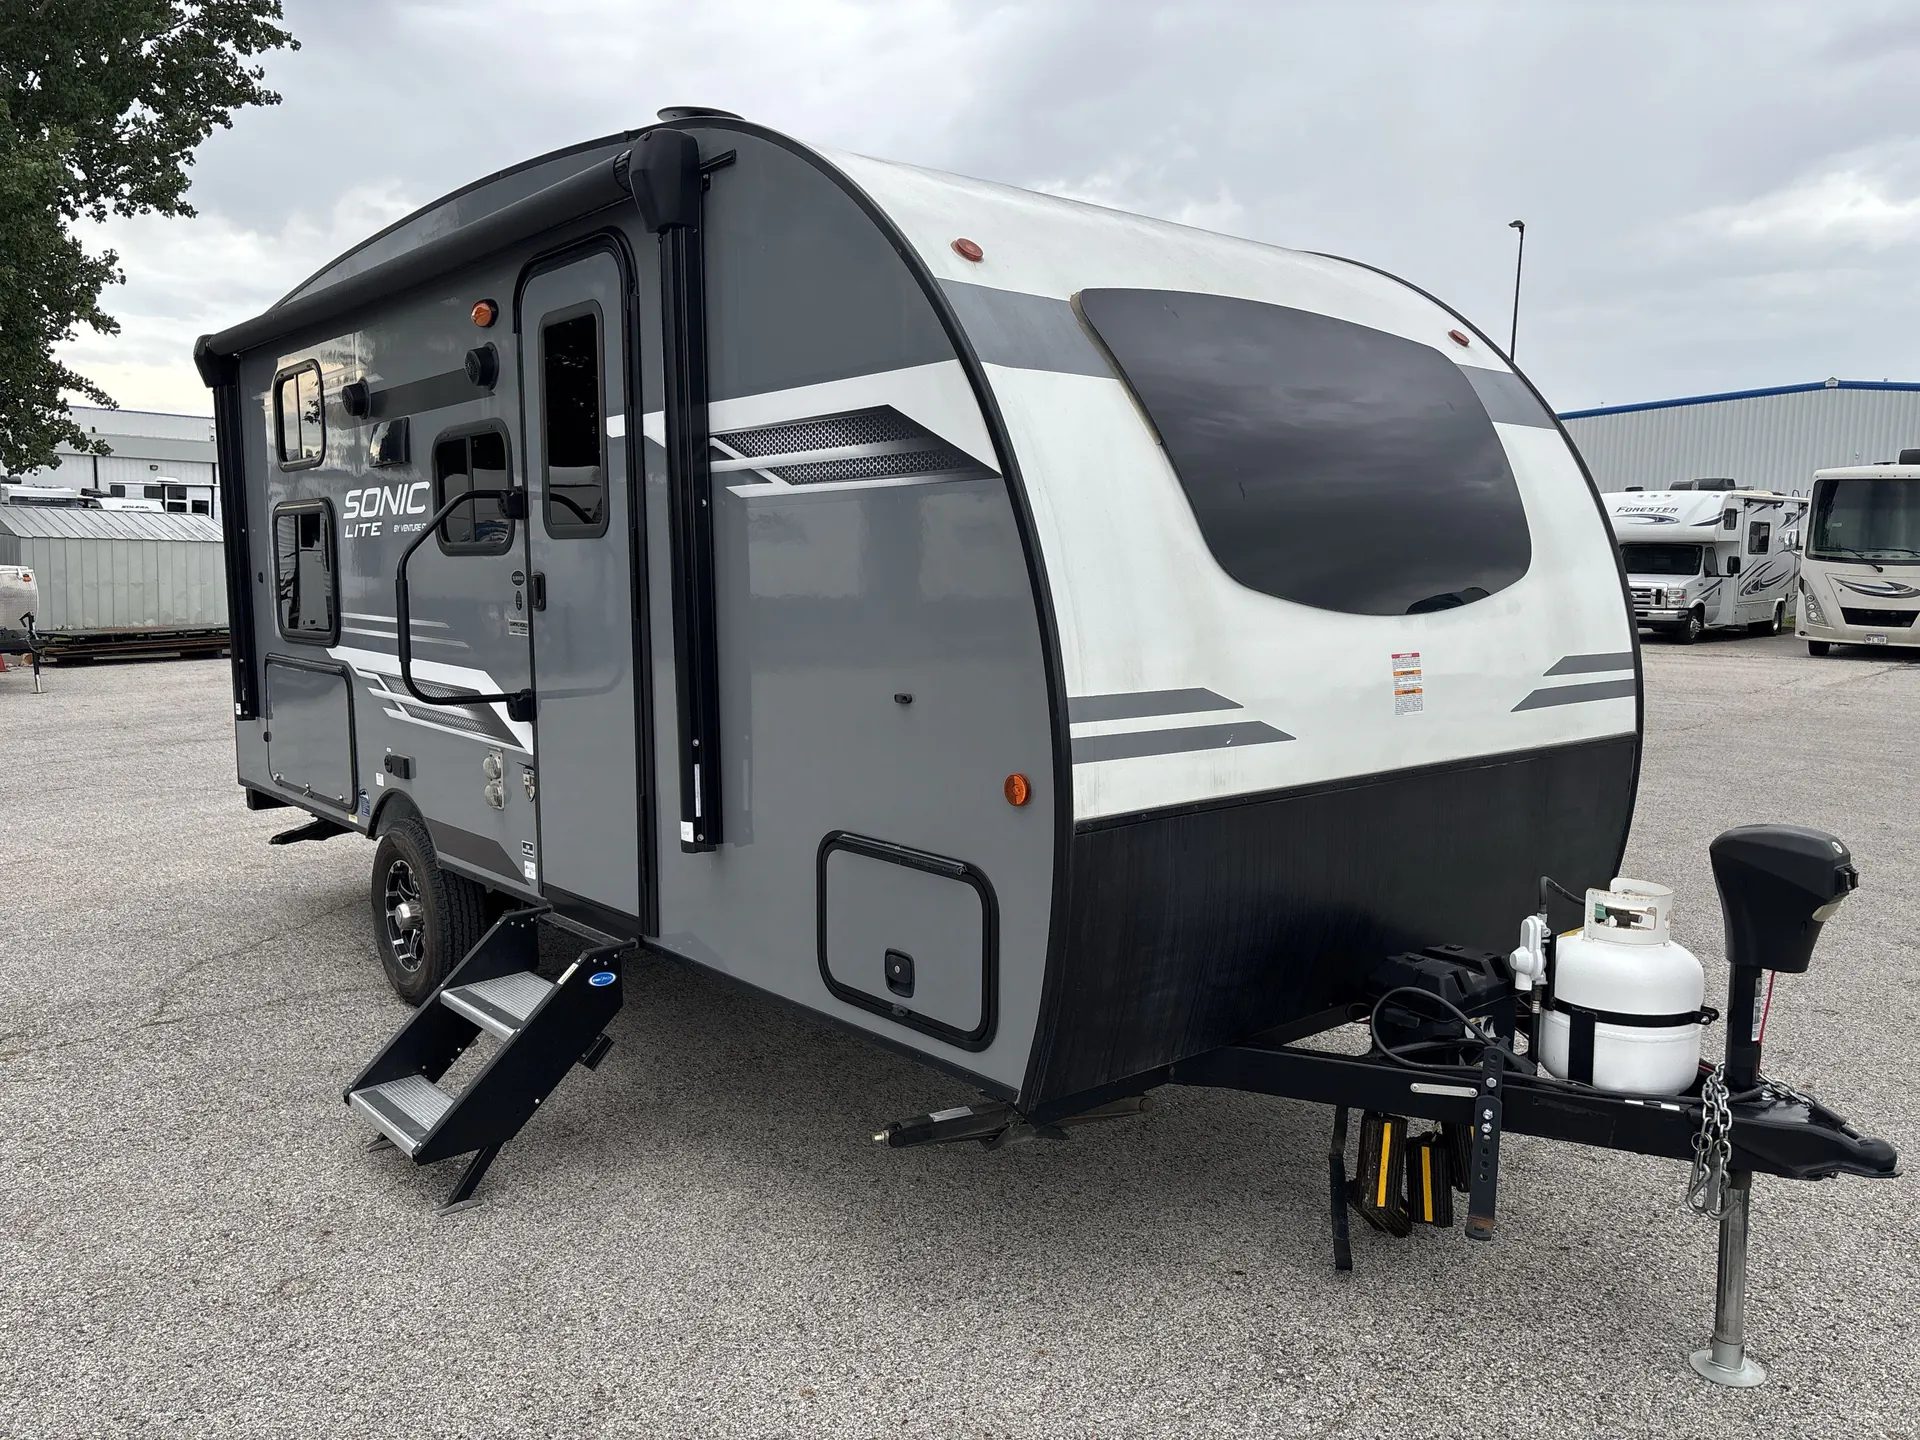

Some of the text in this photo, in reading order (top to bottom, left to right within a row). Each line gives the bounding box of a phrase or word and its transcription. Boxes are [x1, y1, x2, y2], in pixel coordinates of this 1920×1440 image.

[343, 481, 430, 519] SONIC
[345, 522, 382, 538] LITE
[393, 524, 400, 532] BY
[401, 523, 421, 532] VENTURE
